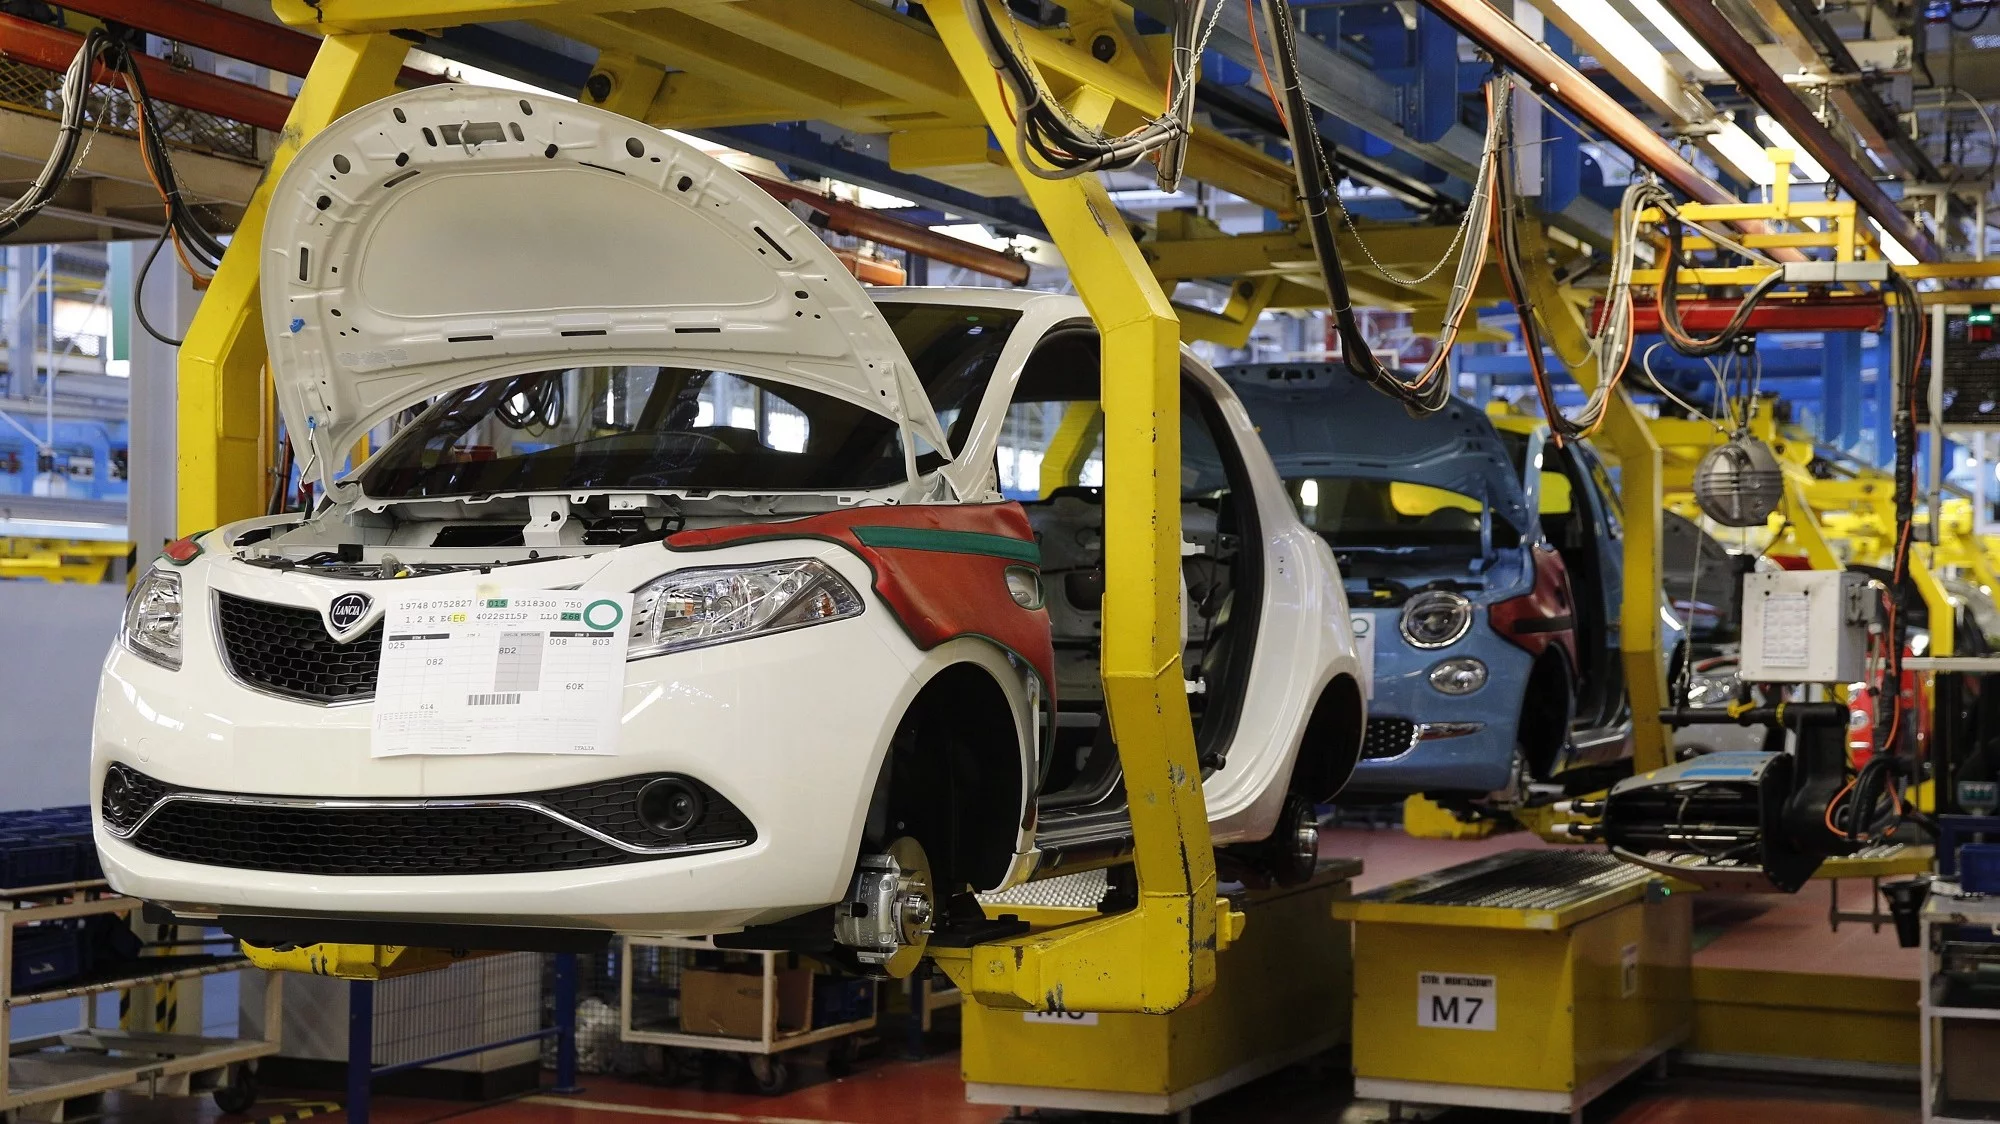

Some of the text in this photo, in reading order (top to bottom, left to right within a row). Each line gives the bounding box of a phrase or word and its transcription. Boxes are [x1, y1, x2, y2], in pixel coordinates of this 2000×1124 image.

[335, 605, 360, 615] LANCIA
[400, 602, 428, 610] 19748
[431, 600, 472, 609] 0752827
[488, 600, 506, 608] 015
[514, 600, 557, 608] 5318300
[564, 601, 582, 609] 750
[428, 615, 435, 623] K
[561, 612, 581, 620] 268
[550, 638, 567, 646] 008
[426, 658, 444, 666] 082
[1432, 995, 1483, 1024] M7
